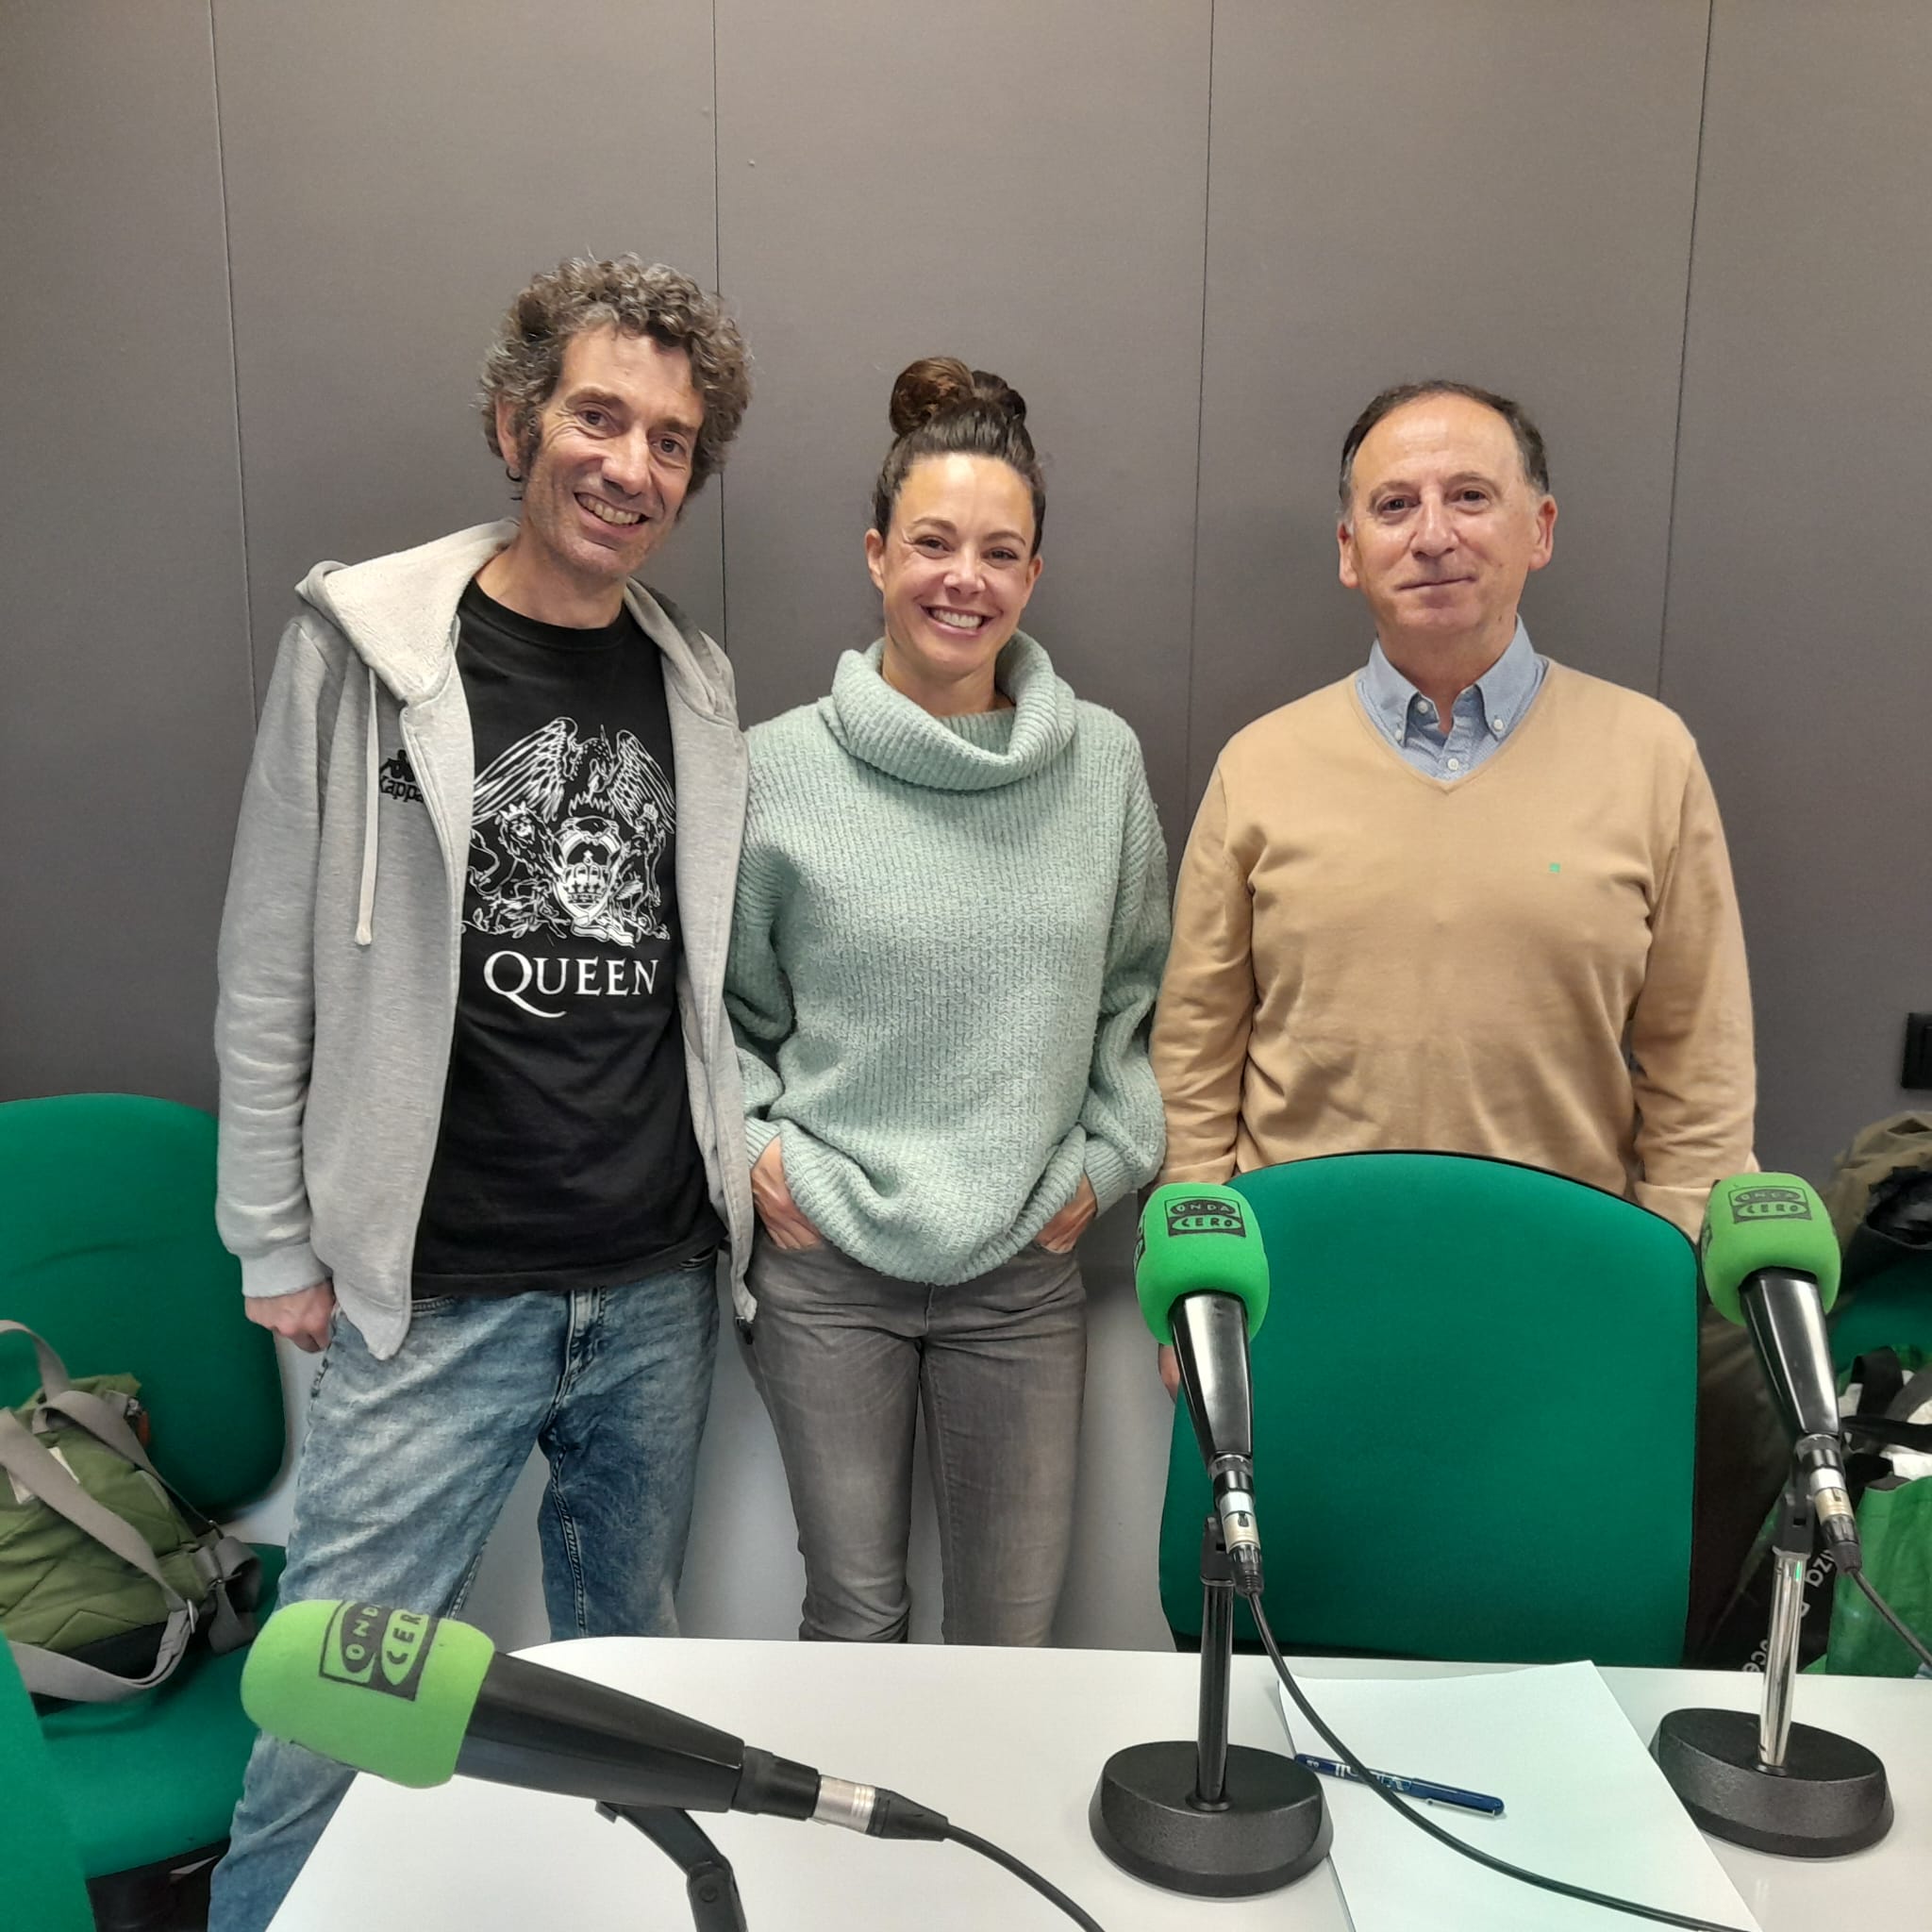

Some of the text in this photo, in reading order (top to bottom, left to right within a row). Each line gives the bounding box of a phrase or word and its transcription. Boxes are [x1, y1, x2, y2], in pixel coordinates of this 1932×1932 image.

[483, 950, 658, 1018] QUEEN
[1176, 1204, 1230, 1212] ONDA
[1182, 1218, 1233, 1227] CERO
[1747, 1204, 1798, 1214] CERO
[345, 1606, 379, 1660] OND
[386, 1614, 422, 1665] CER
